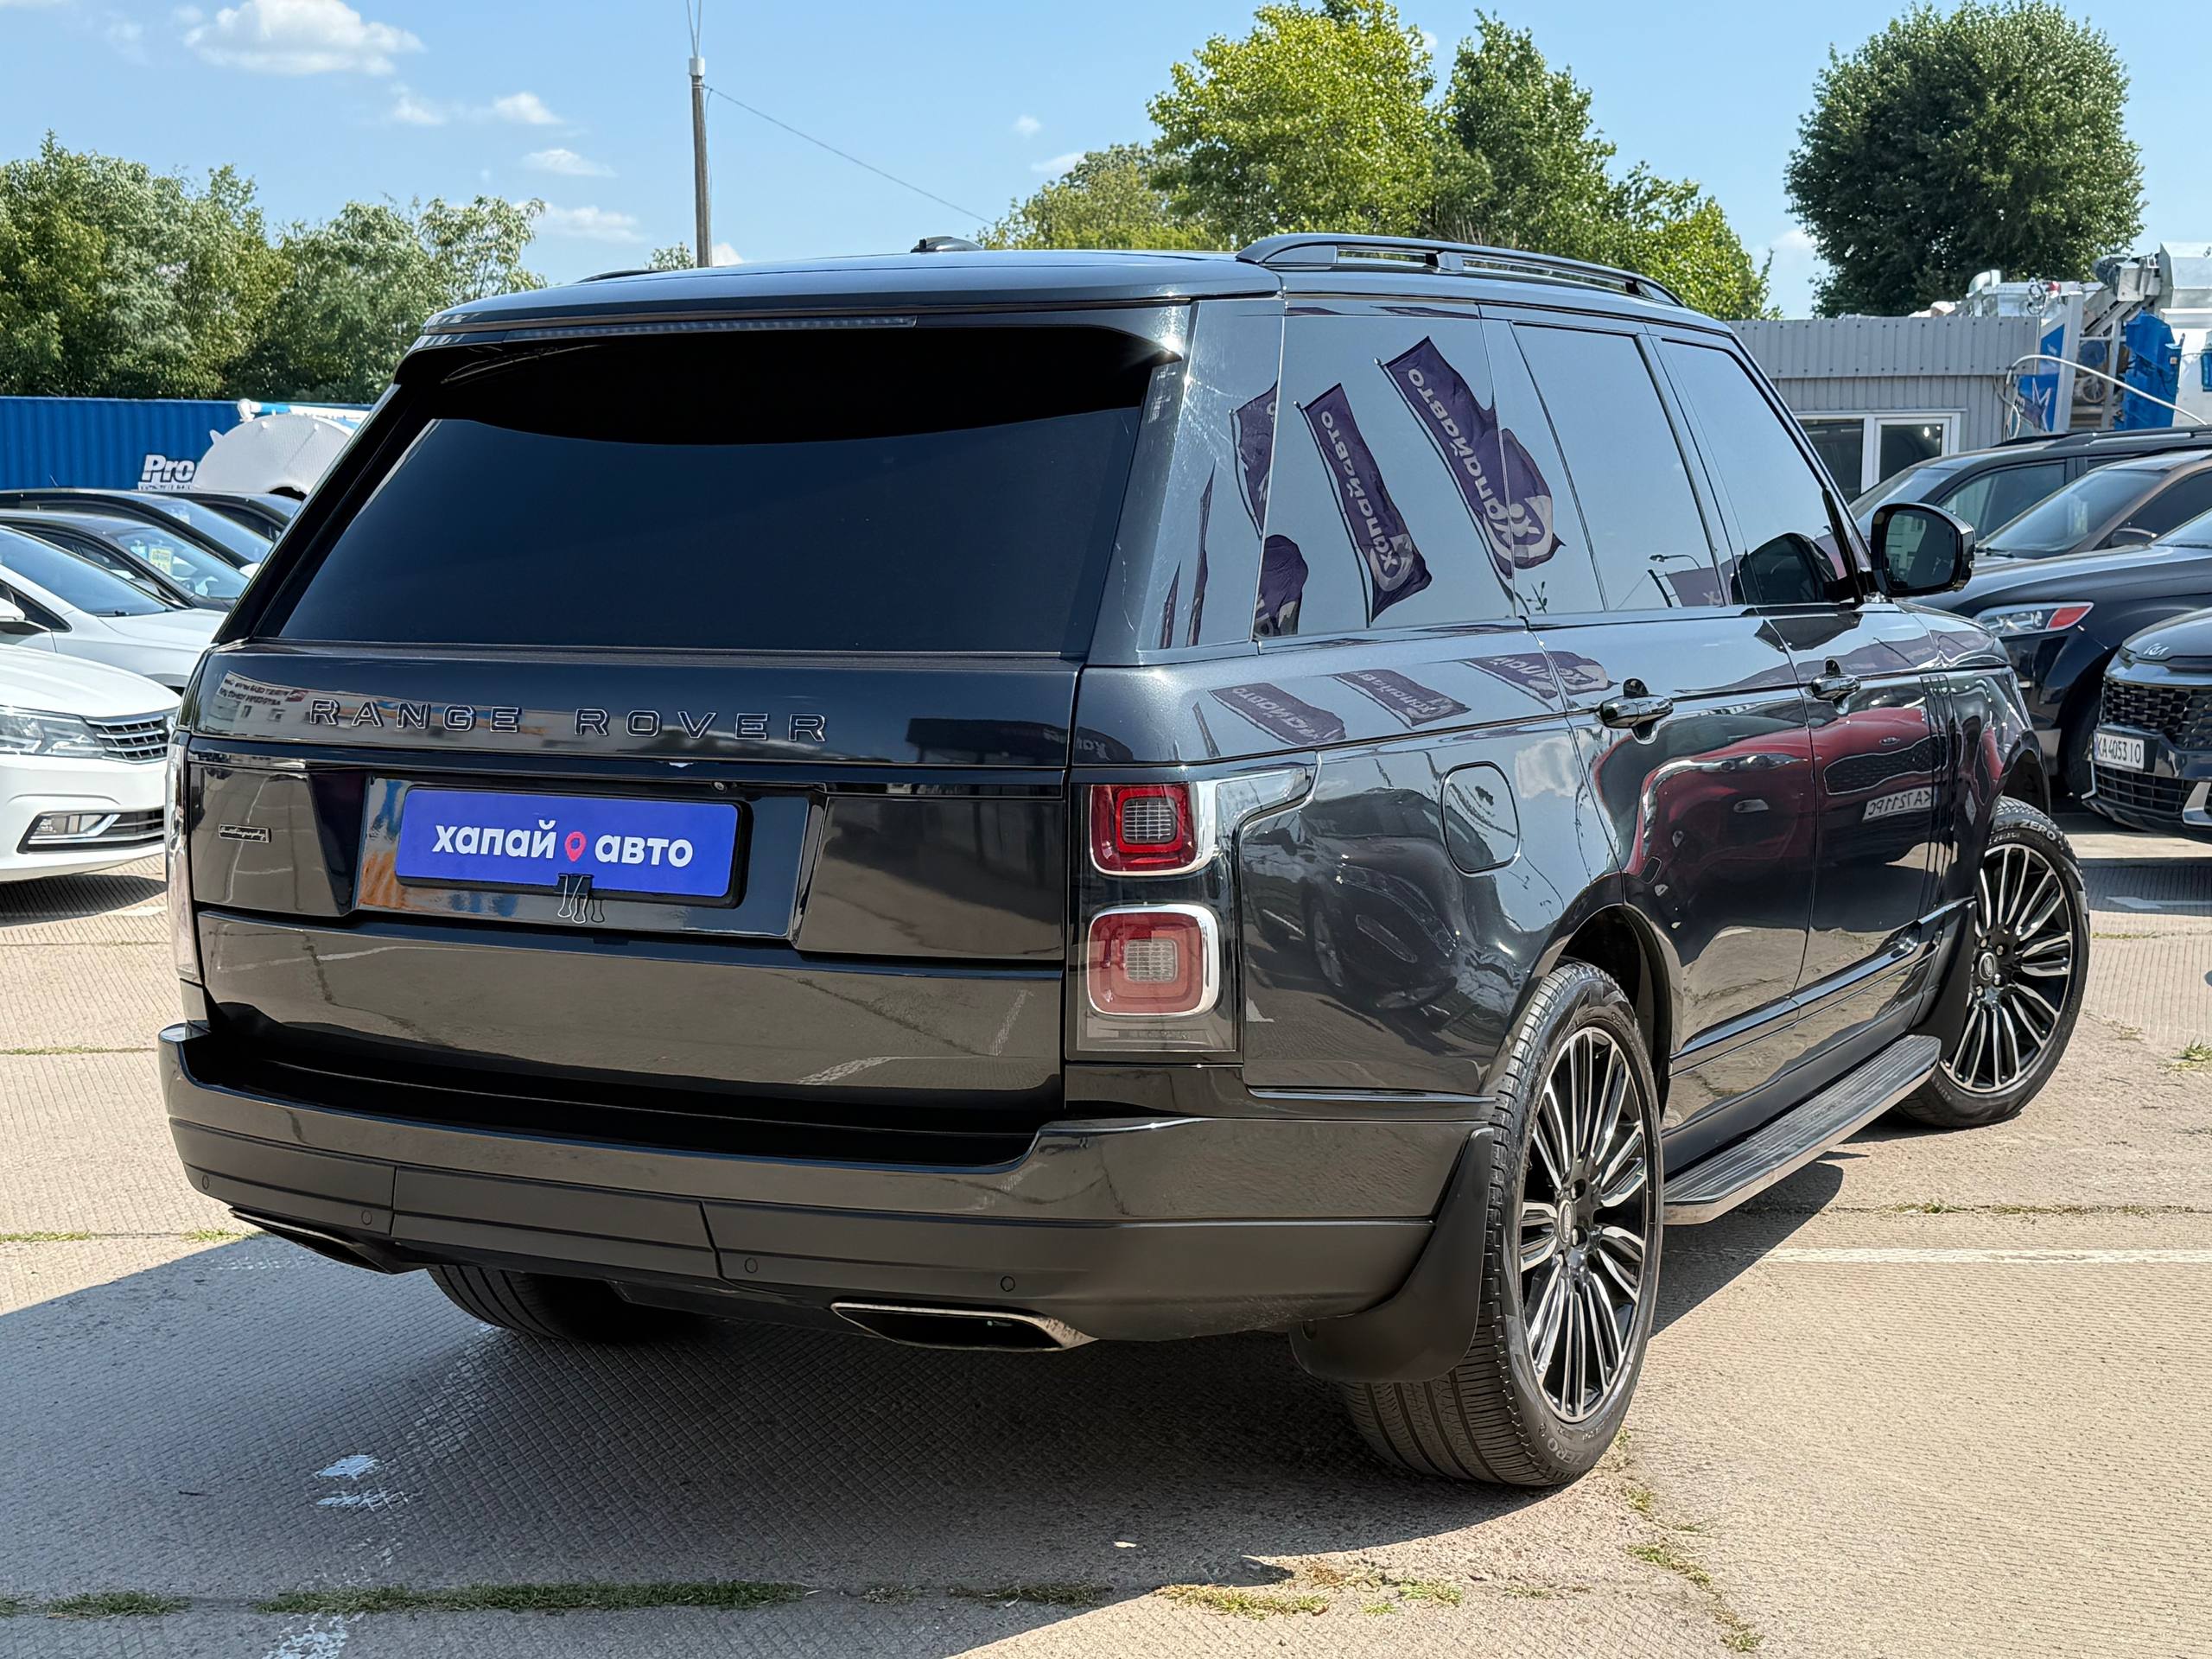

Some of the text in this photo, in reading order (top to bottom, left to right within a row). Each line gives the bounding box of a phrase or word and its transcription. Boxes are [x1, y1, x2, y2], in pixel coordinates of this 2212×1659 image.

[308, 698, 826, 742] RANGE ROVER
[432, 819, 694, 868] хапай авто
[2019, 818, 2056, 841] ZERO
